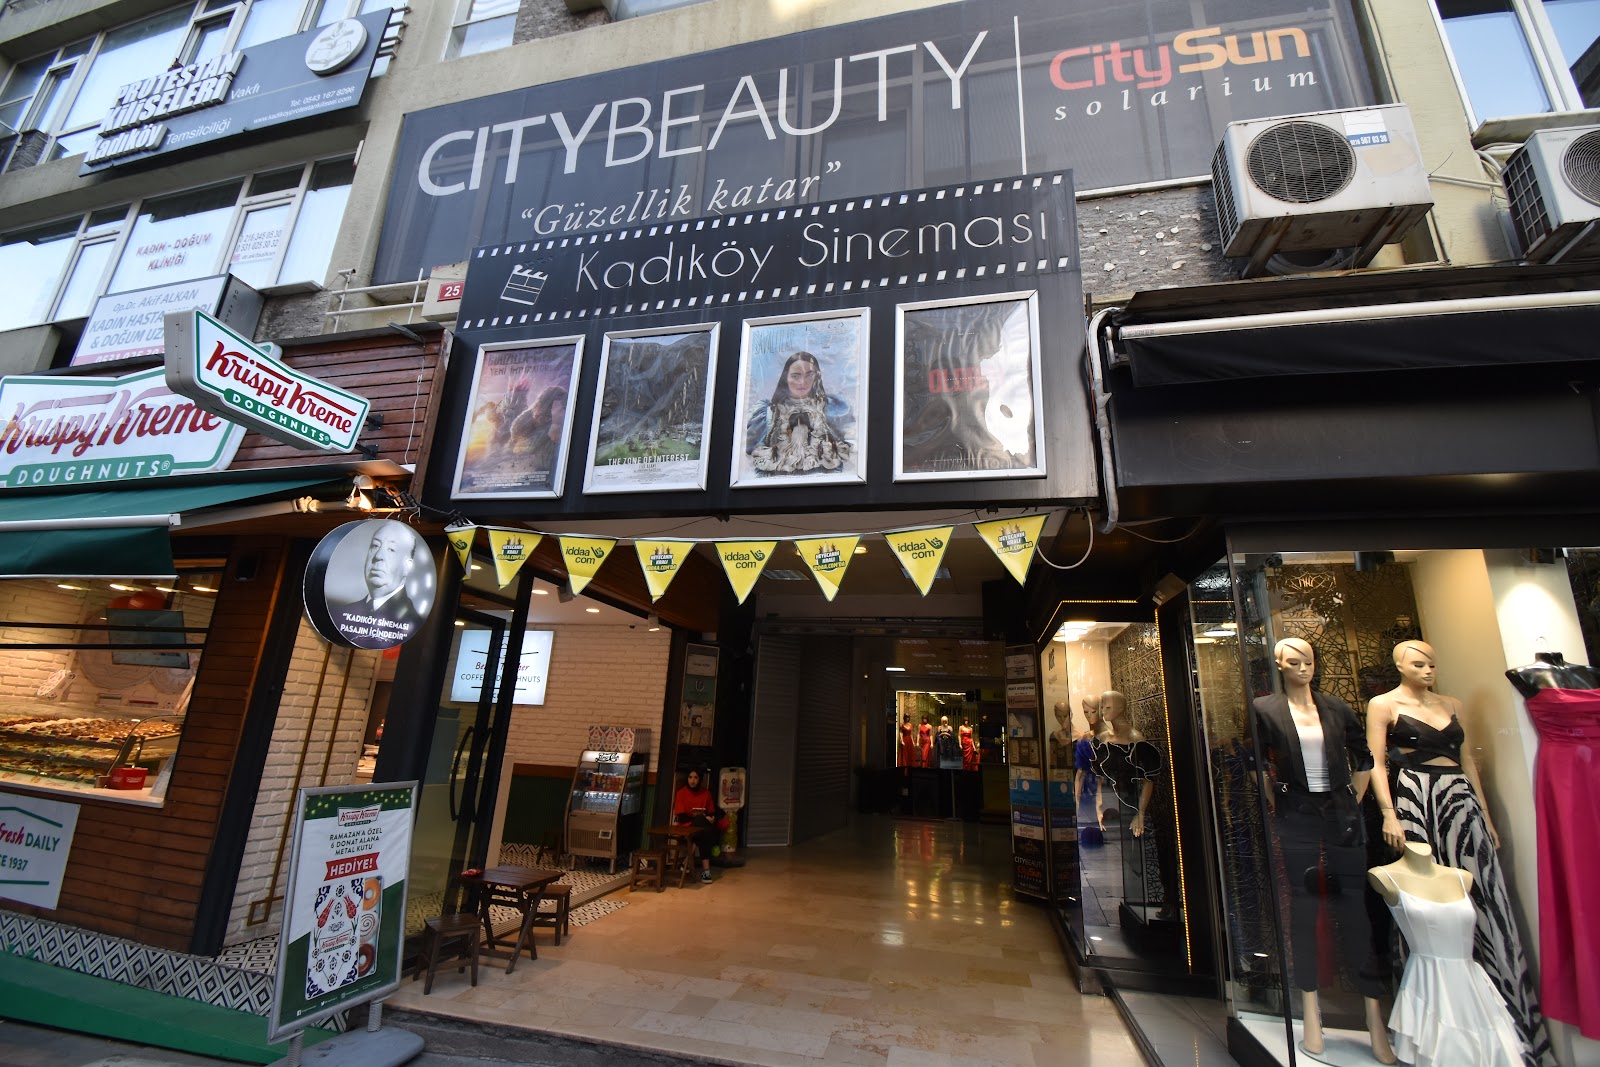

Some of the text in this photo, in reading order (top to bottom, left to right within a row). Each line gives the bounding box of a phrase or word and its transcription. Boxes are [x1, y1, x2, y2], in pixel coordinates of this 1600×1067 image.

[117, 50, 242, 106] PROTESTAN
[1054, 69, 1318, 121] solarium
[418, 30, 989, 196] CITYBEAUTY
[166, 118, 232, 146] Temsilciliği
[136, 242, 166, 256] KADIN
[174, 232, 213, 250] DOĞUM
[576, 211, 1047, 296] Kadıköy Sineması
[138, 293, 161, 308] Akif
[161, 288, 200, 305] ALKAN
[444, 286, 460, 297] 25
[89, 313, 128, 333] KADIN
[90, 339, 99, 349] &
[100, 327, 144, 348] DOĞUM
[205, 340, 357, 434] Krispy Kreme
[0, 386, 221, 456] Krispy Kreme
[608, 453, 690, 466] THE ZONE OF INTEREST
[565, 546, 590, 557] iddaa
[897, 541, 926, 552] iddaa
[575, 556, 595, 565] com
[724, 551, 750, 562] iddaa
[911, 549, 935, 560] com
[735, 559, 757, 569] com
[340, 624, 368, 635] PASAJIN
[378, 618, 410, 631] SİNEMASI
[25, 832, 60, 852] DAILY
[330, 830, 365, 840] RAMAZAN'A
[336, 838, 357, 847] DONAT
[359, 836, 379, 844] ALANA
[357, 844, 373, 852] KUTU
[9, 857, 28, 871] 1937
[330, 858, 373, 877] HEDİYE!
